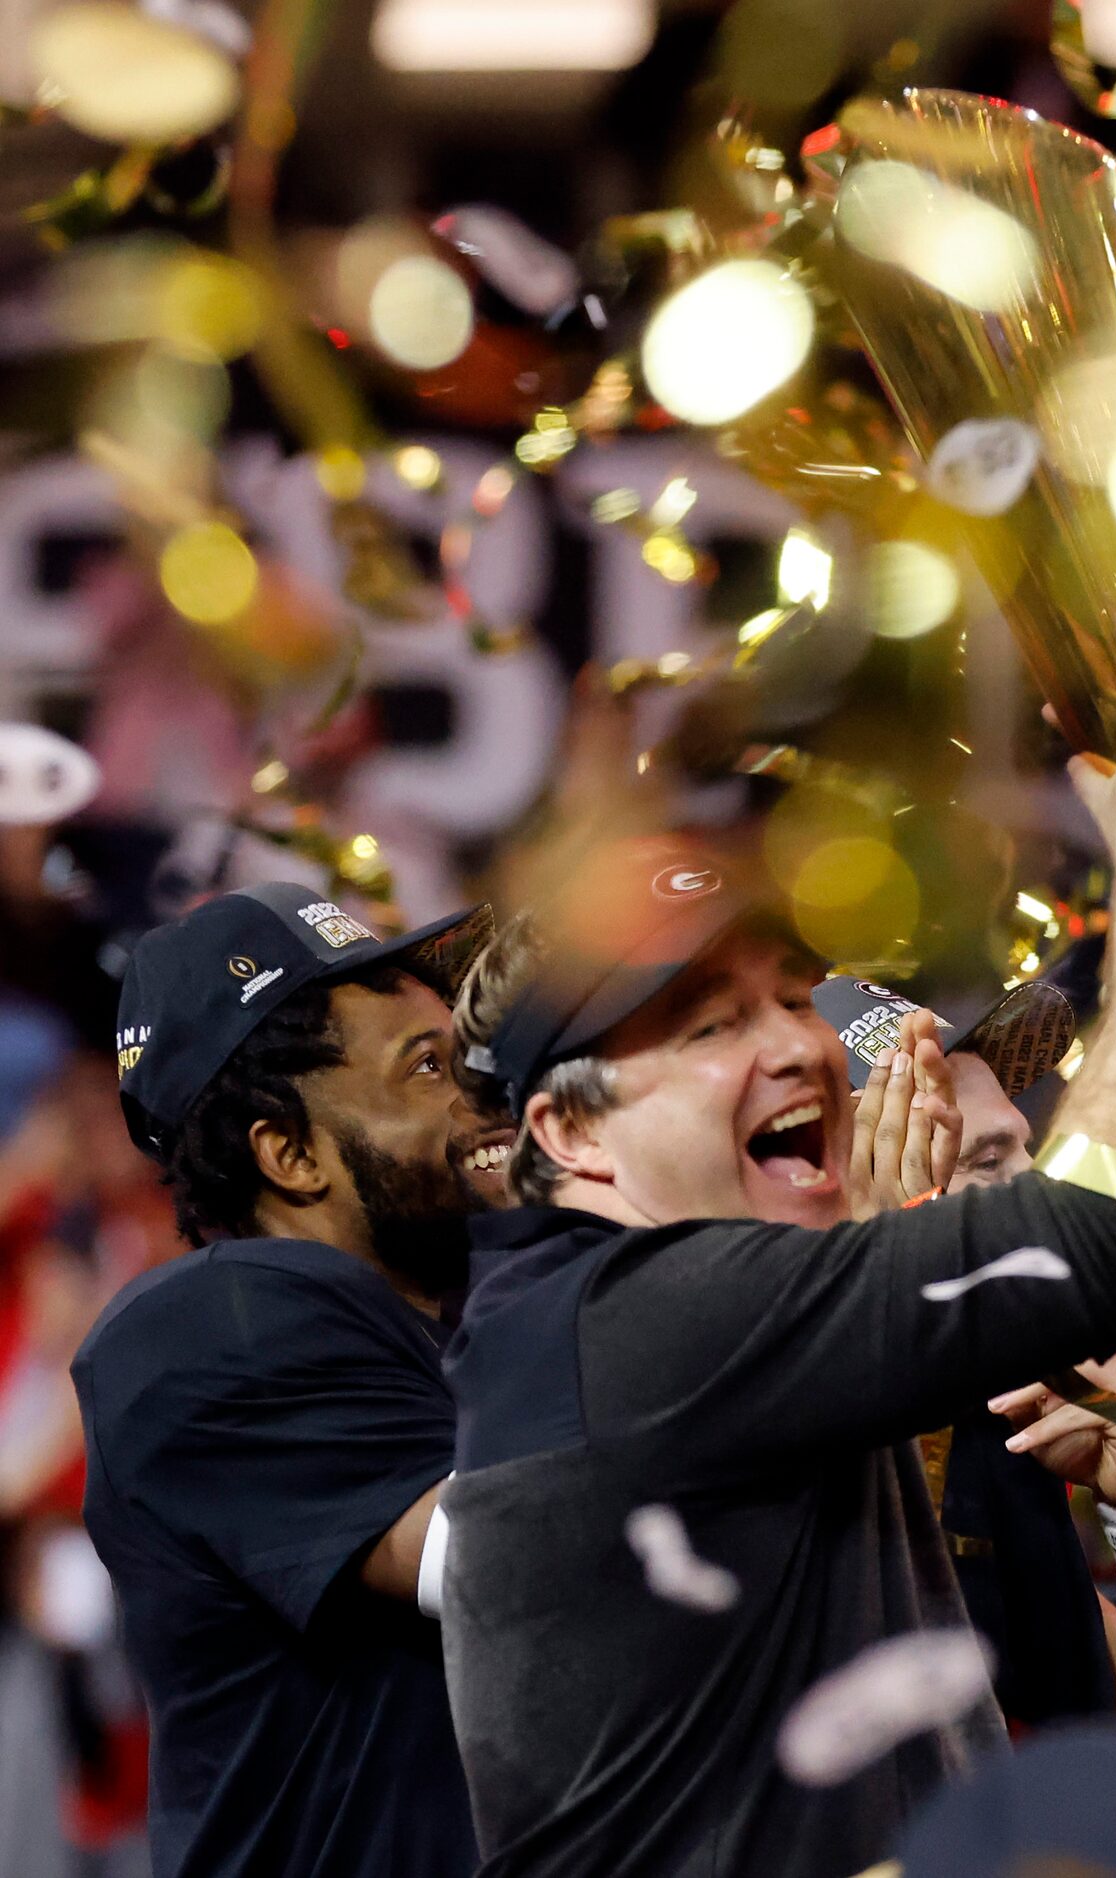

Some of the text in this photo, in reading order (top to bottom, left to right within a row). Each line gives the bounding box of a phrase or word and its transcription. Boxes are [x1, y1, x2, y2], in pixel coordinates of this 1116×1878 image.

[240, 967, 284, 1003] CHAMPIONSHIP
[242, 970, 273, 992] NATIONAL
[838, 1005, 898, 1049] 2022
